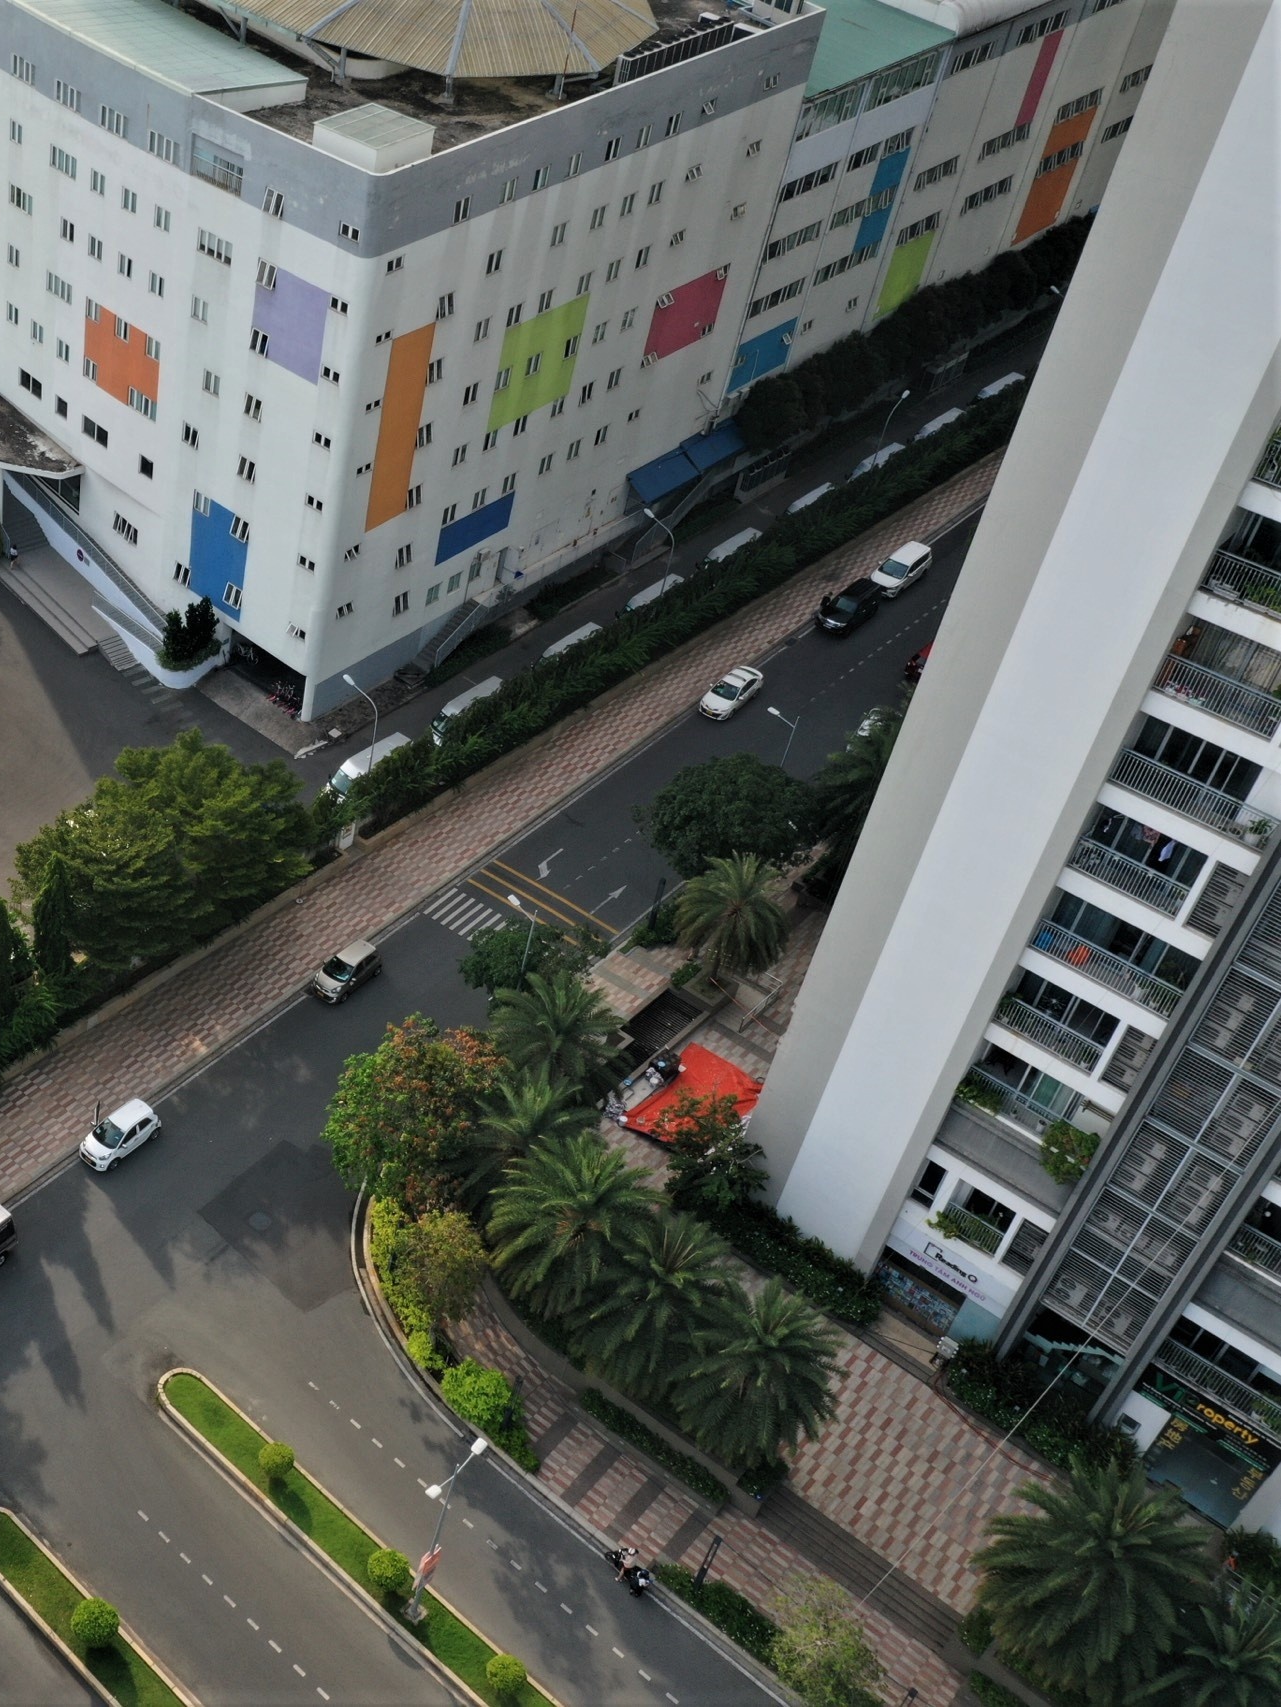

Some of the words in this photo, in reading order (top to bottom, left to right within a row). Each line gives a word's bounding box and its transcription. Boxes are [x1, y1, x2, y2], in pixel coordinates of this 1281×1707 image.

[909, 1250, 933, 1268] TRUNG
[951, 1277, 968, 1291] ANH
[935, 1252, 967, 1278] Reading
